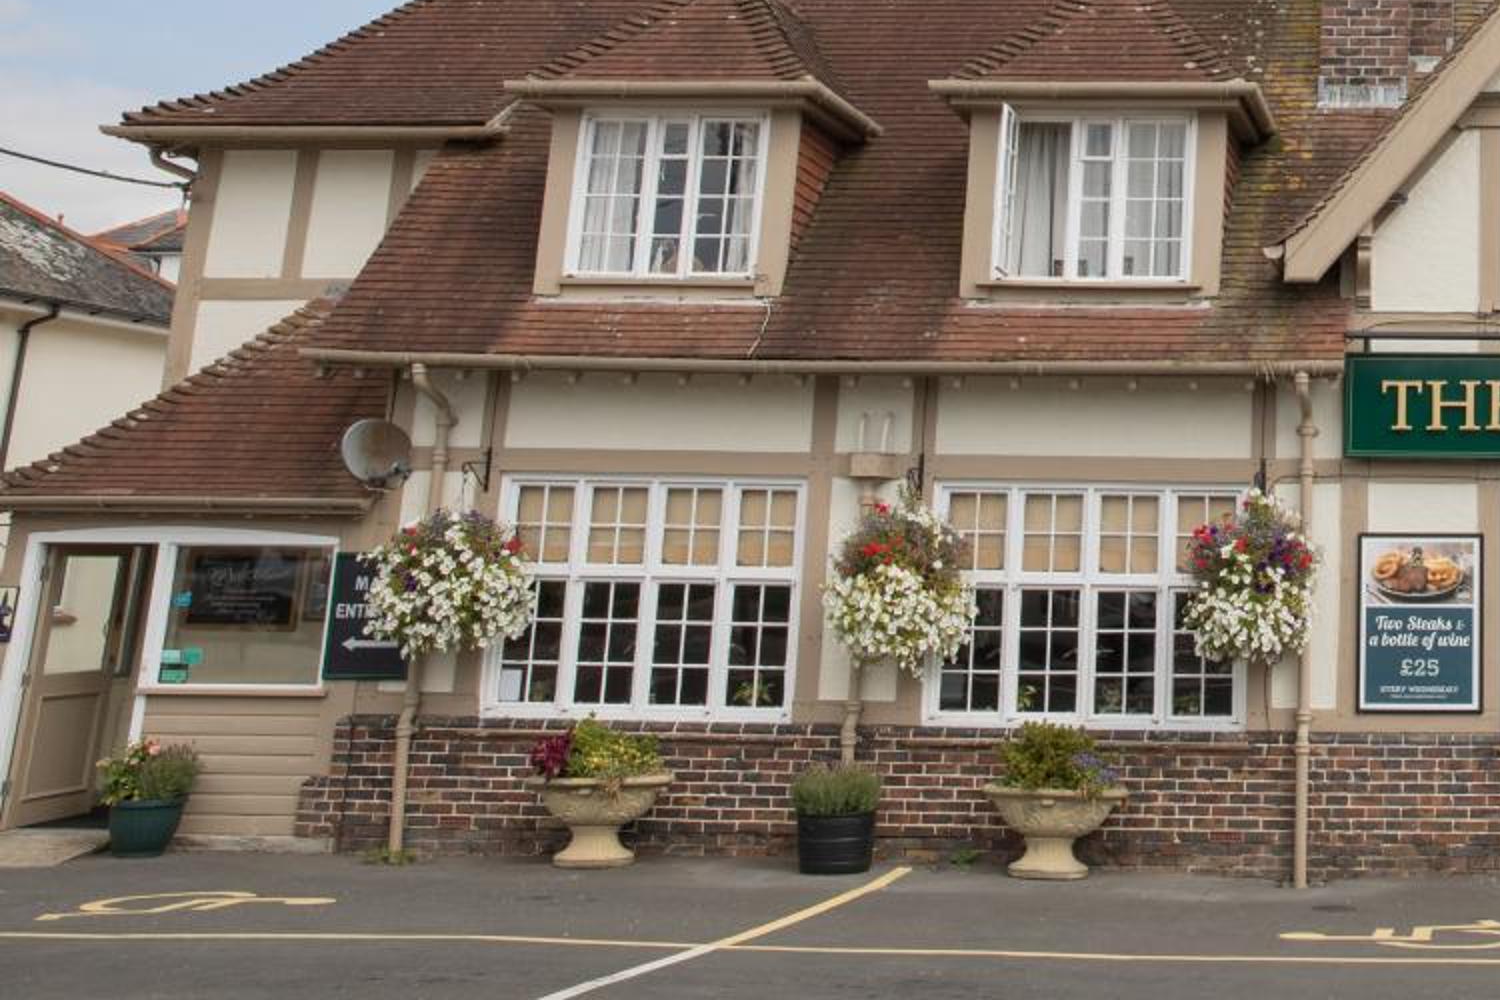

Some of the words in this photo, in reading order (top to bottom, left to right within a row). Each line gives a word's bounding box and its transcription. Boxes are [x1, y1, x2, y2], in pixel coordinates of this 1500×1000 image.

[1375, 615, 1404, 631] Two
[1407, 615, 1453, 631] Steaks
[1368, 634, 1379, 647] a
[1381, 632, 1419, 647] bottle
[1421, 631, 1437, 651] of
[1437, 633, 1471, 647] wine
[1400, 658, 1440, 677] £25
